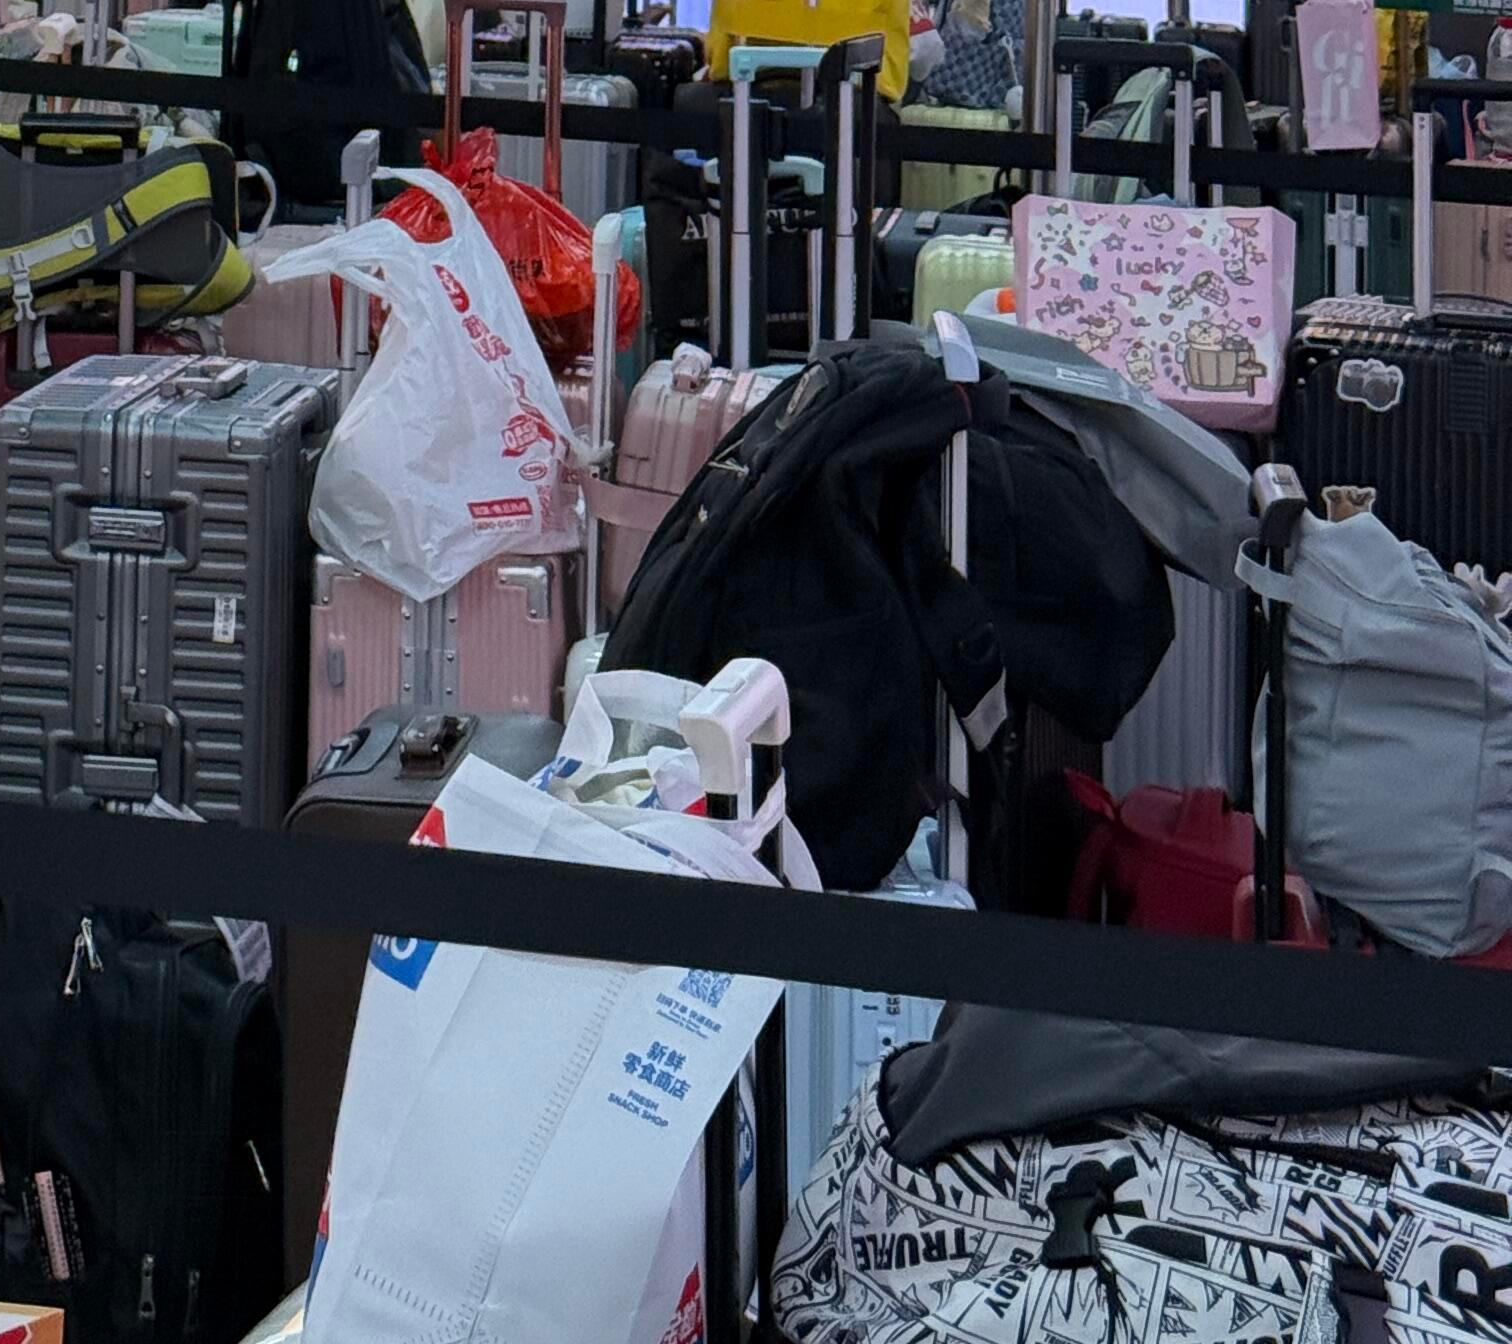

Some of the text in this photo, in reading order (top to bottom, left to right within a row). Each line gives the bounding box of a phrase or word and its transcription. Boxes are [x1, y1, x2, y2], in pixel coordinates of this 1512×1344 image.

[1116, 256, 1185, 276] lucky
[646, 1040, 687, 1072] 新鲜
[622, 1051, 692, 1102] 零食商店
[607, 1092, 670, 1129] SNACK SHOP
[626, 1088, 660, 1111] FRESH
